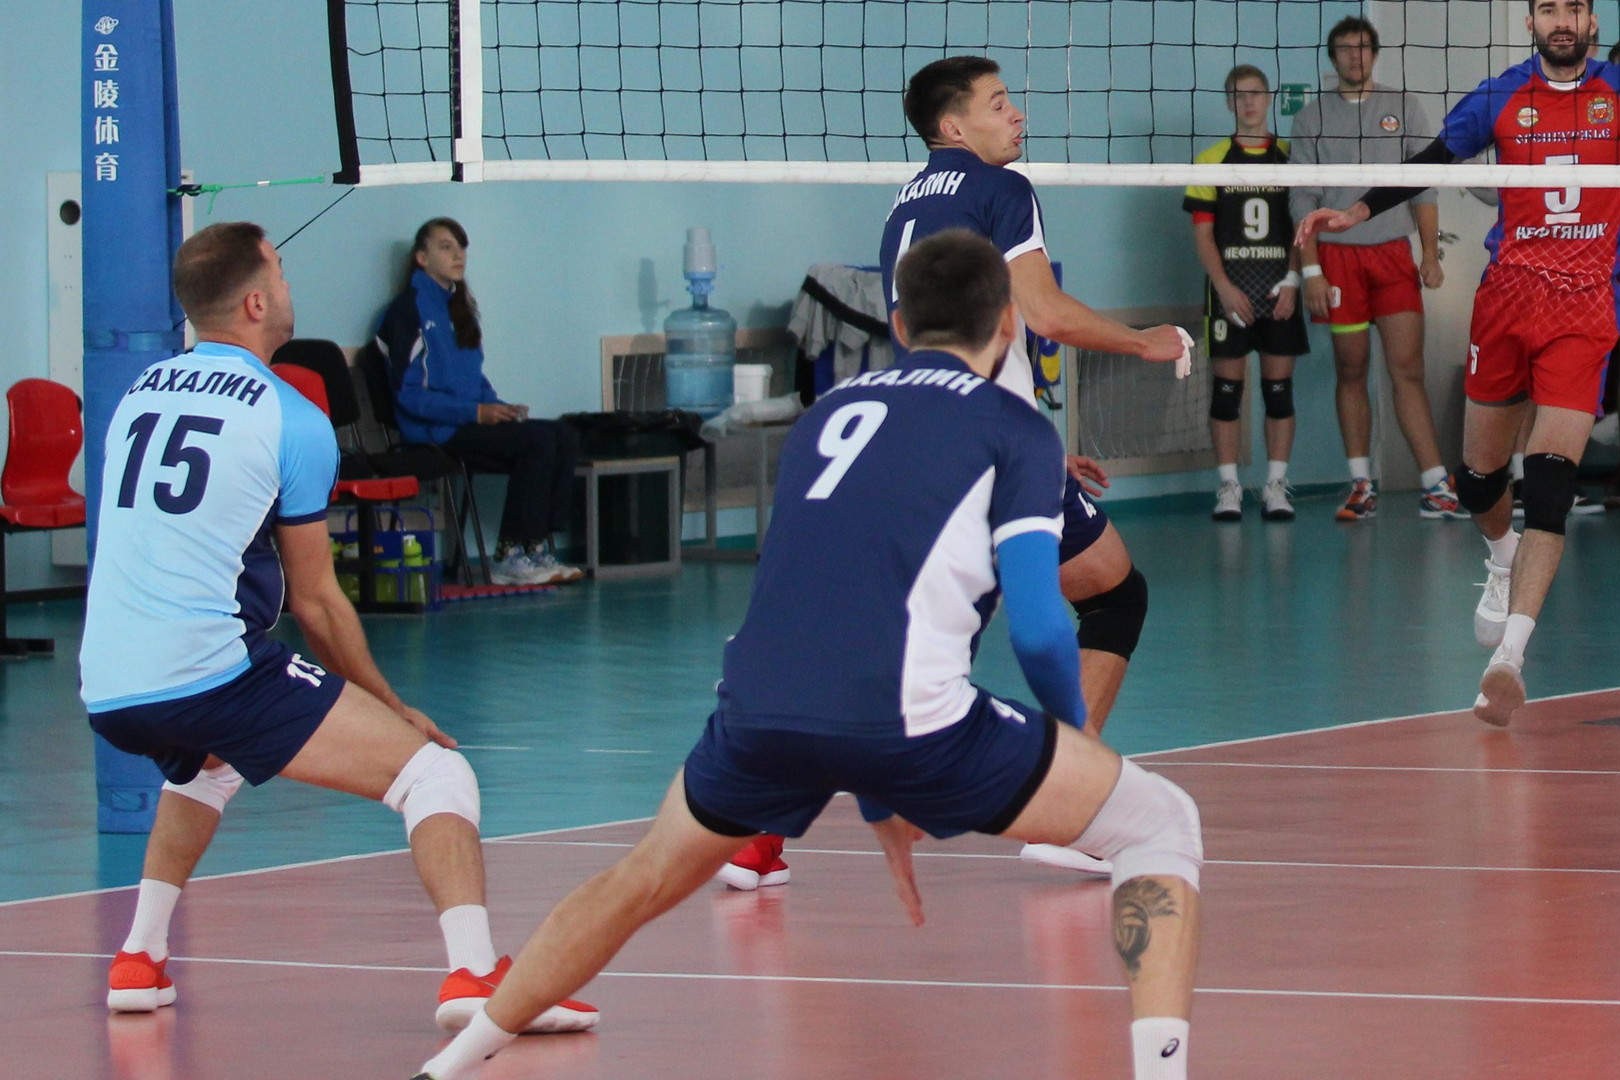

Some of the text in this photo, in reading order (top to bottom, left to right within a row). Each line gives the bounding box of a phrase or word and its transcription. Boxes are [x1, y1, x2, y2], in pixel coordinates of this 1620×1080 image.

[94, 43, 120, 182] 金陵体育
[1244, 198, 1270, 240] 9
[1516, 223, 1608, 241] НЕФТЯНИК
[1213, 319, 1228, 342] 9
[117, 412, 225, 515] 15
[805, 400, 889, 500] 9
[286, 652, 327, 688] 15
